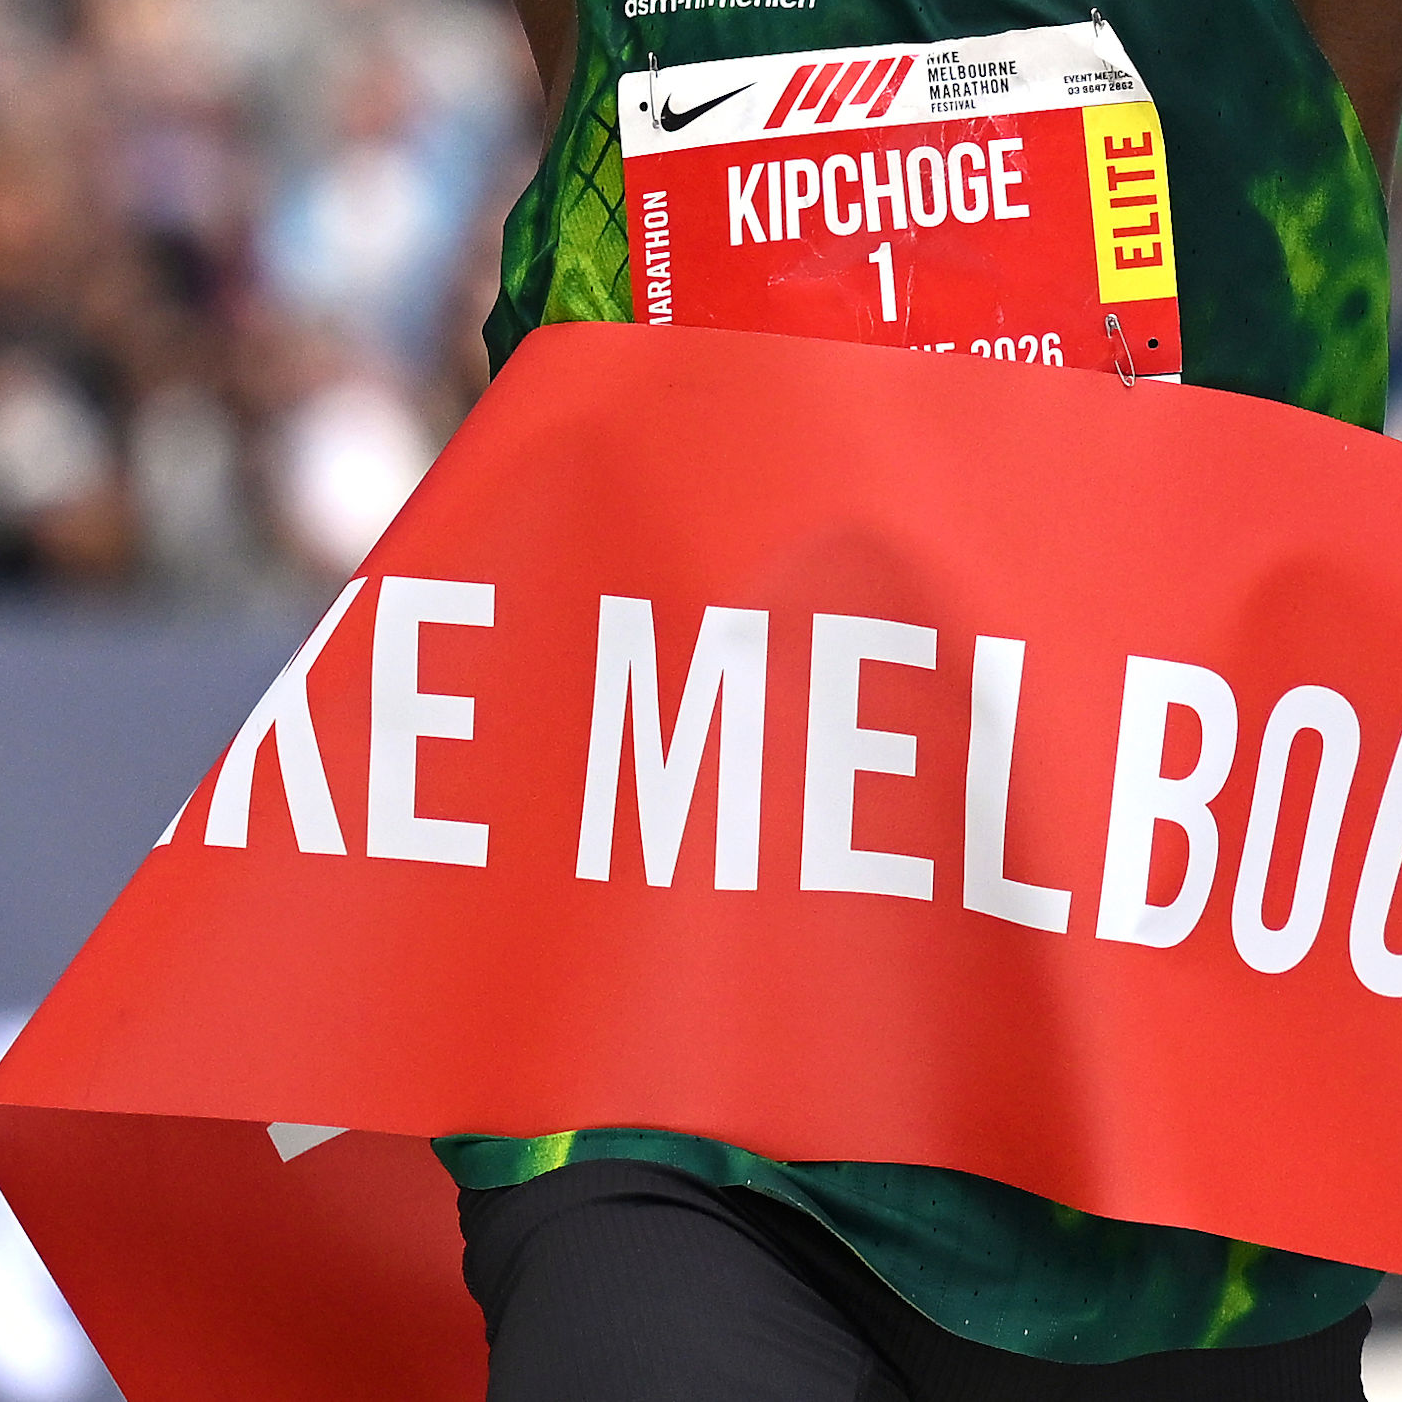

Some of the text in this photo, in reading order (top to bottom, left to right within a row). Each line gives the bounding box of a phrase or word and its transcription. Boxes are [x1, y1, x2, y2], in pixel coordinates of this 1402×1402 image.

[928, 60, 1018, 82] MELBOURNE
[929, 78, 1010, 100] MARATHON
[1063, 73, 1092, 84] EVENT
[931, 99, 976, 113] FESTIVAL
[727, 137, 1030, 246] KIPCHOGE
[1104, 131, 1163, 270] ELITE
[868, 241, 897, 322] 1
[152, 575, 496, 868] KE
